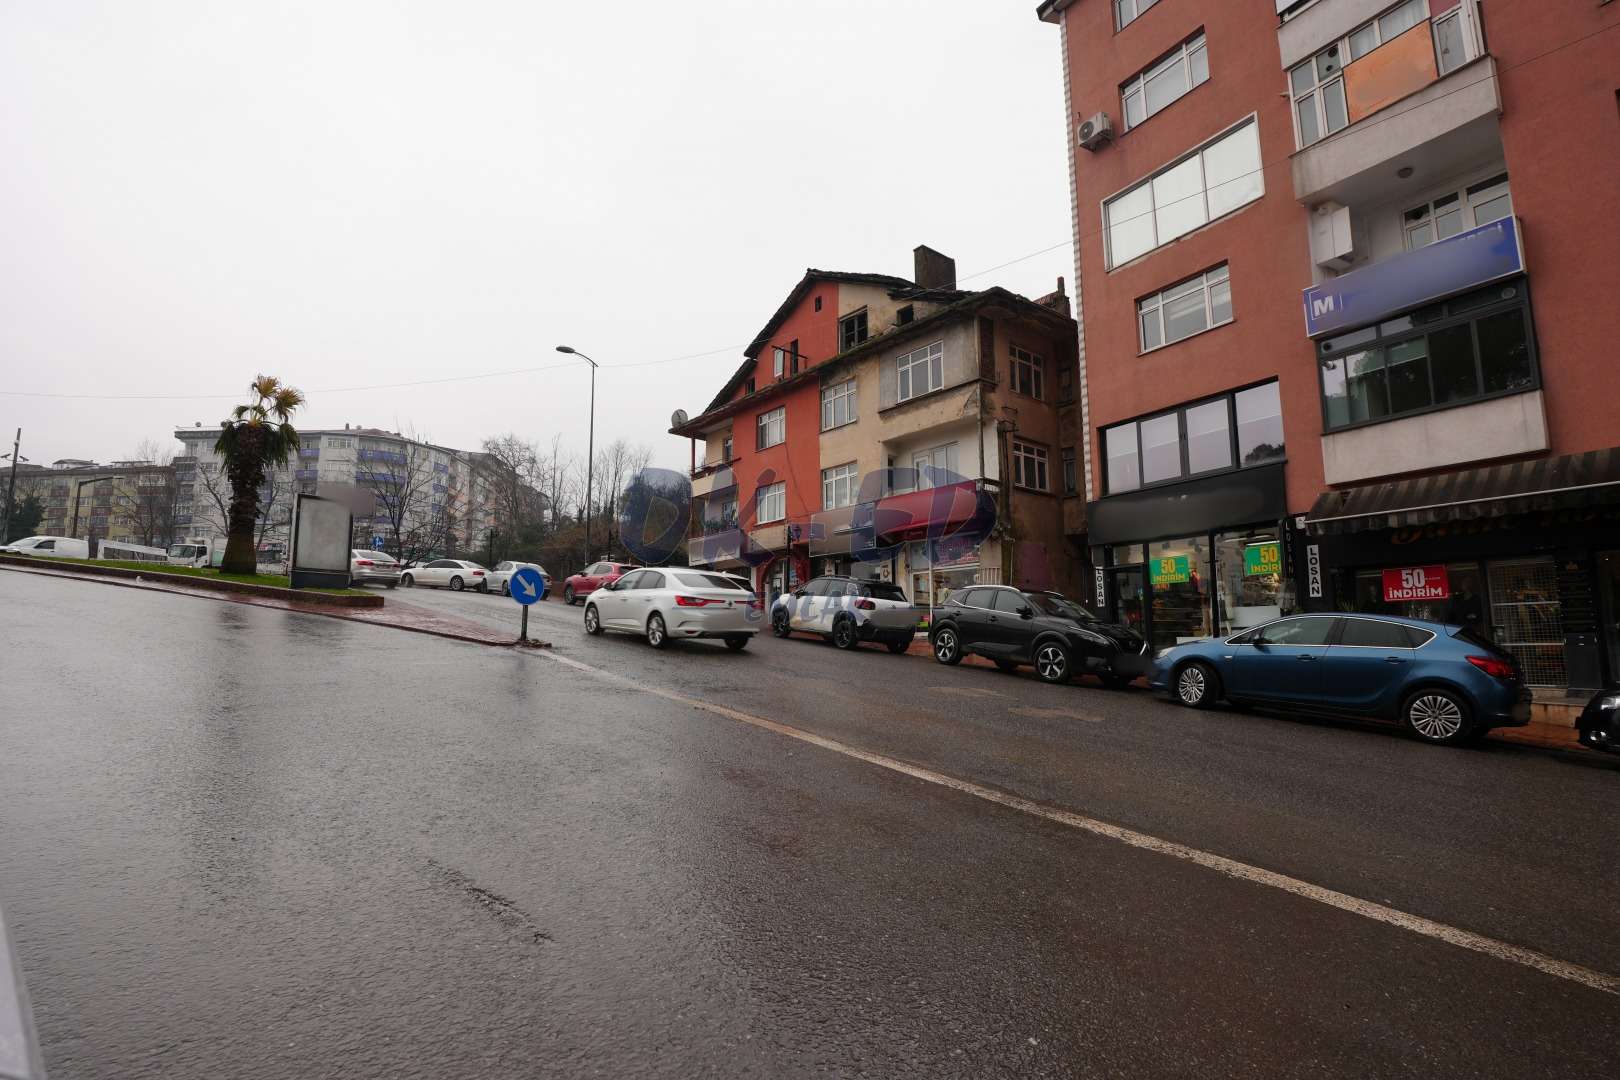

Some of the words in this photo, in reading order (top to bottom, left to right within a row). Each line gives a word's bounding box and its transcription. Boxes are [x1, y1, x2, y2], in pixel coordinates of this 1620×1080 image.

[1260, 546, 1278, 563] 50
[1161, 559, 1176, 574] 50
[1309, 547, 1320, 595] LOSAN
[1096, 569, 1104, 606] LOSAN
[1401, 569, 1425, 589] 50
[1388, 585, 1443, 599] İNDİRİM
